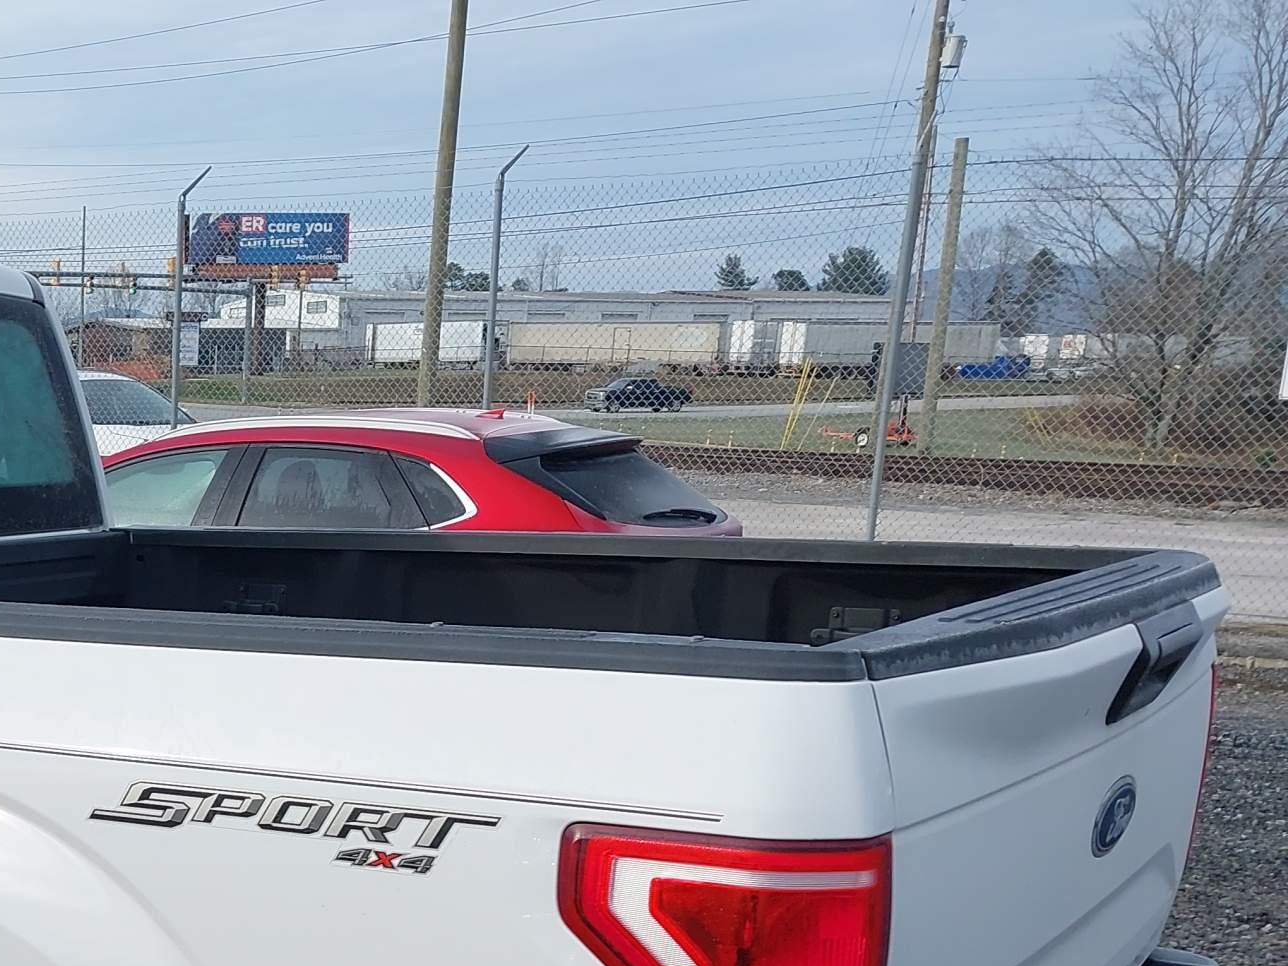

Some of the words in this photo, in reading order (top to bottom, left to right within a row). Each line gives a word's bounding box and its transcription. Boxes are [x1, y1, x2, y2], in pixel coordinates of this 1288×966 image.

[241, 216, 264, 232] ER
[268, 221, 300, 233] care
[305, 222, 333, 235] you
[239, 237, 266, 248] can
[89, 780, 503, 850] SPORT
